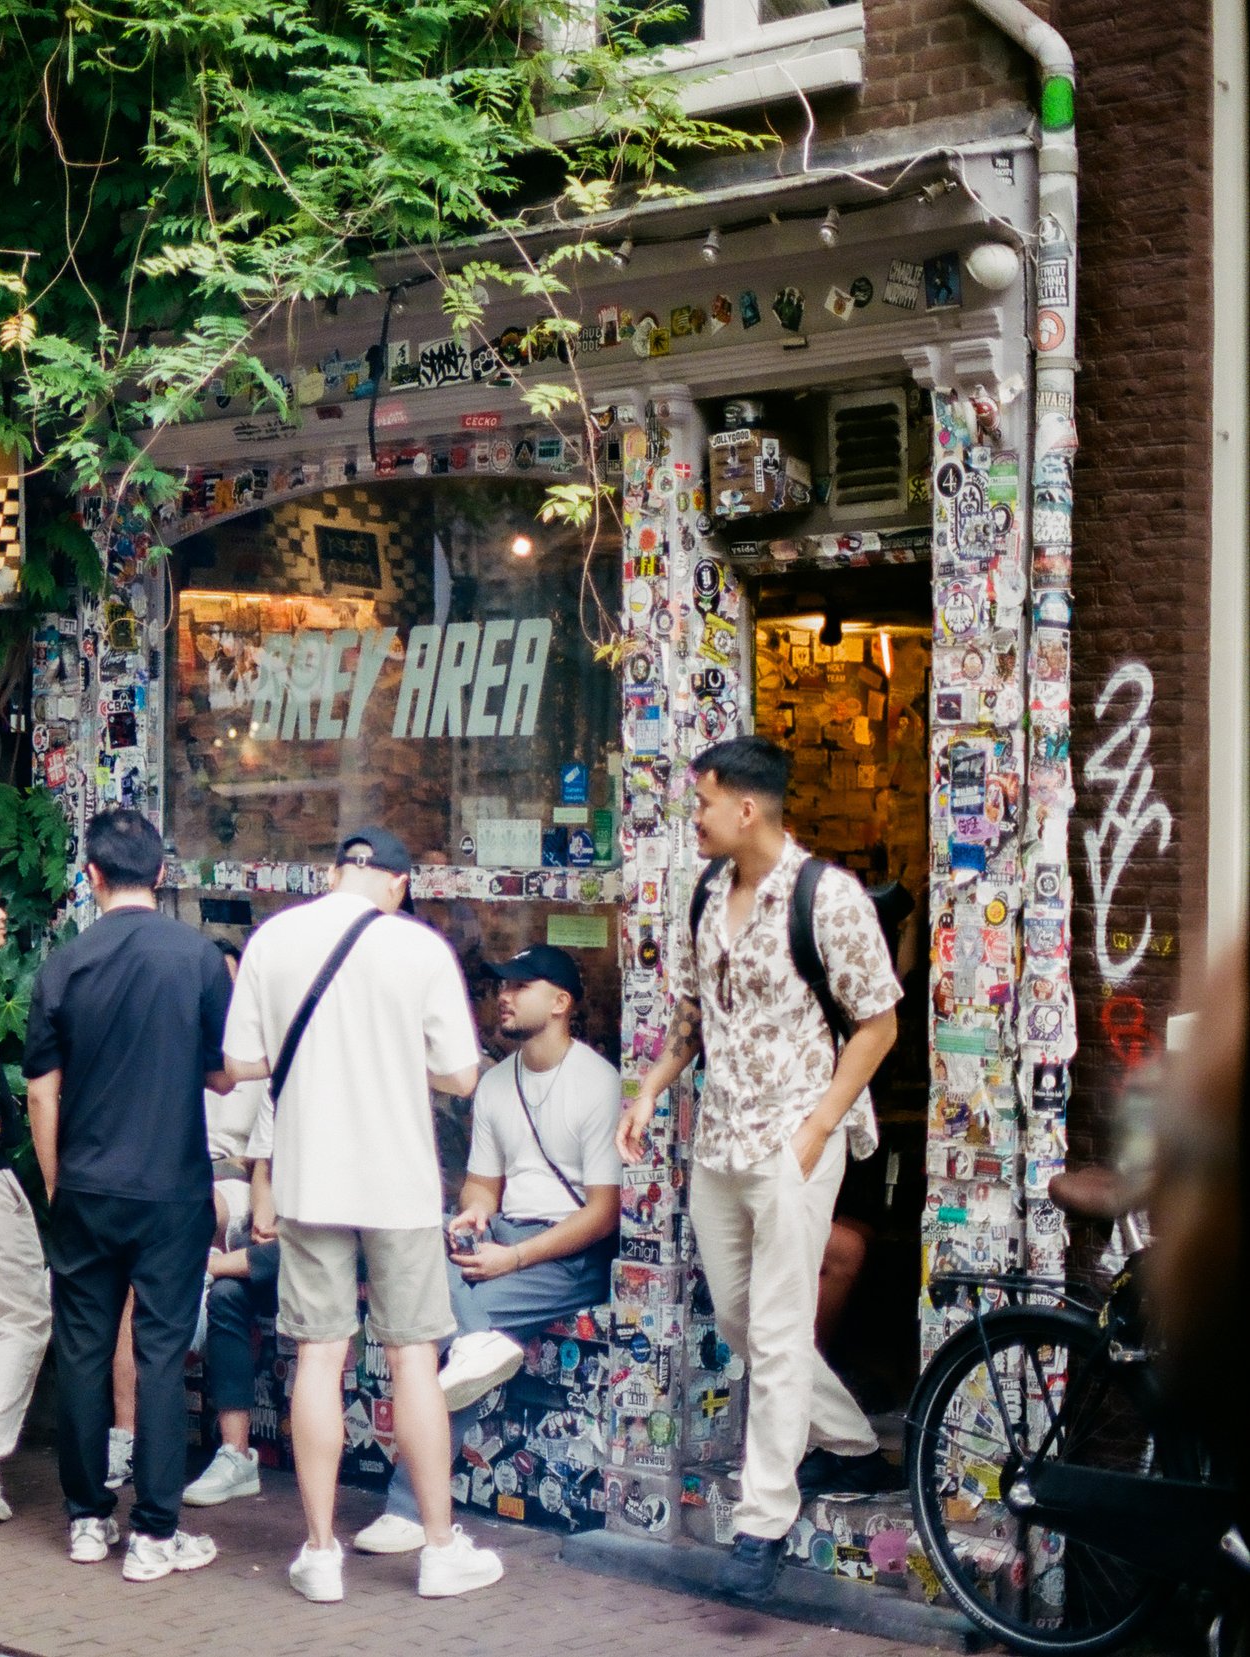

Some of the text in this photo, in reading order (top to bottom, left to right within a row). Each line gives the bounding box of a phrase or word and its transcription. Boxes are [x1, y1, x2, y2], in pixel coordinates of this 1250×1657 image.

[465, 415, 498, 427] CECKO
[392, 617, 553, 739] AREA
[626, 1240, 659, 1263] 2high
